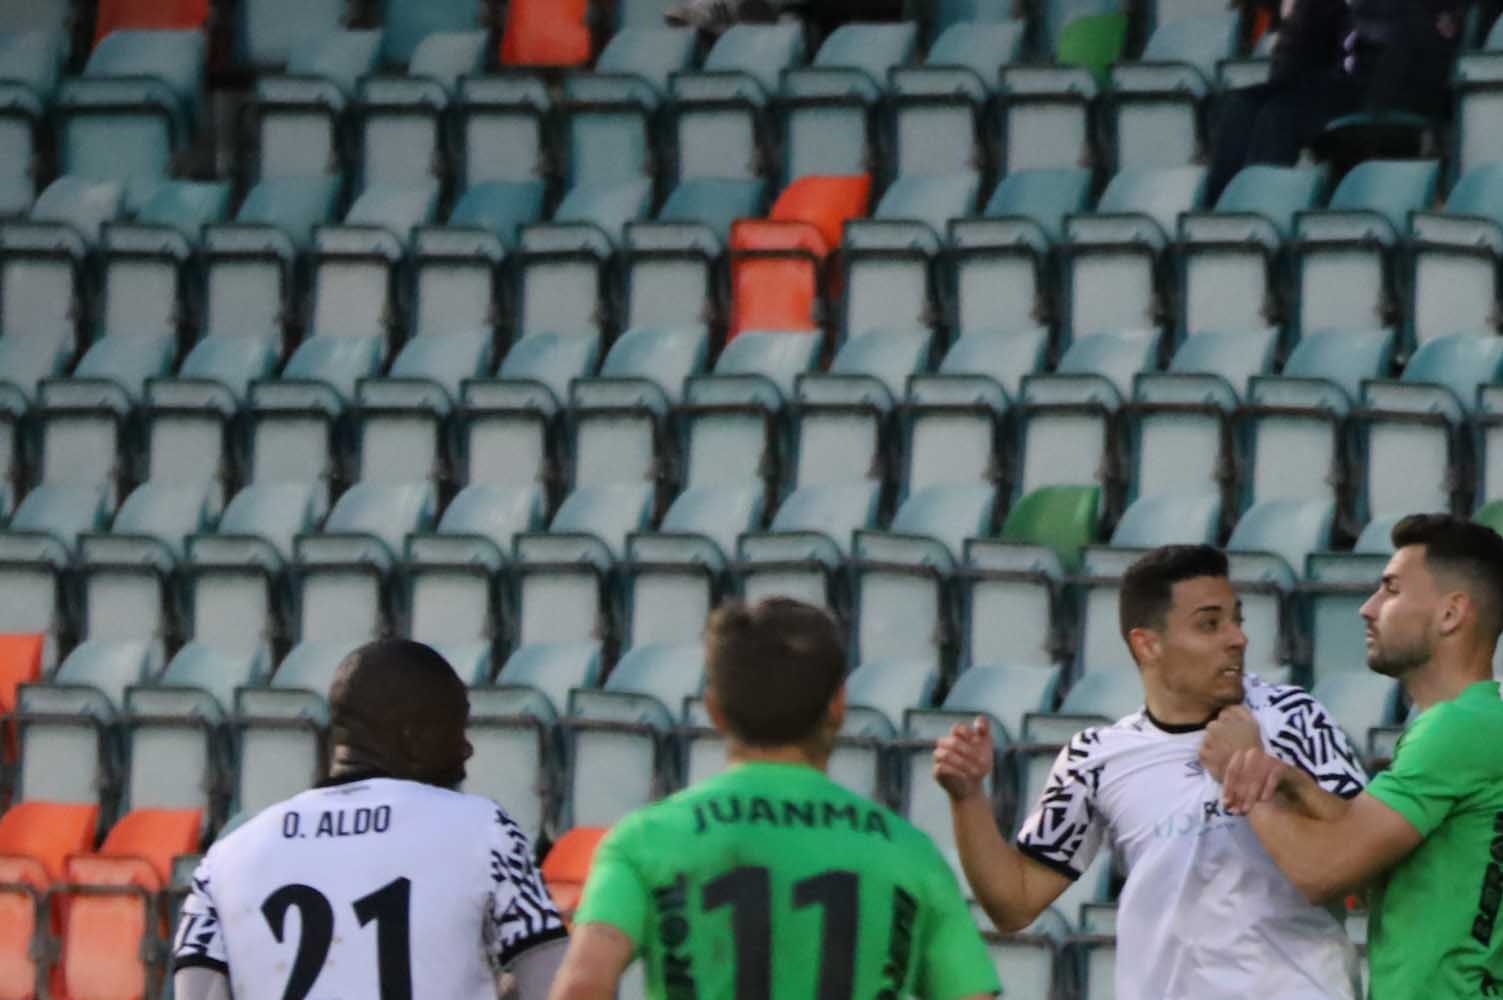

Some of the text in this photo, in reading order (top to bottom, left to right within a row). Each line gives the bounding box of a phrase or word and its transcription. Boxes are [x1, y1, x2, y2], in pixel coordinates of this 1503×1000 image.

[283, 804, 392, 839] O. ALDO
[693, 794, 893, 842] JUANMA
